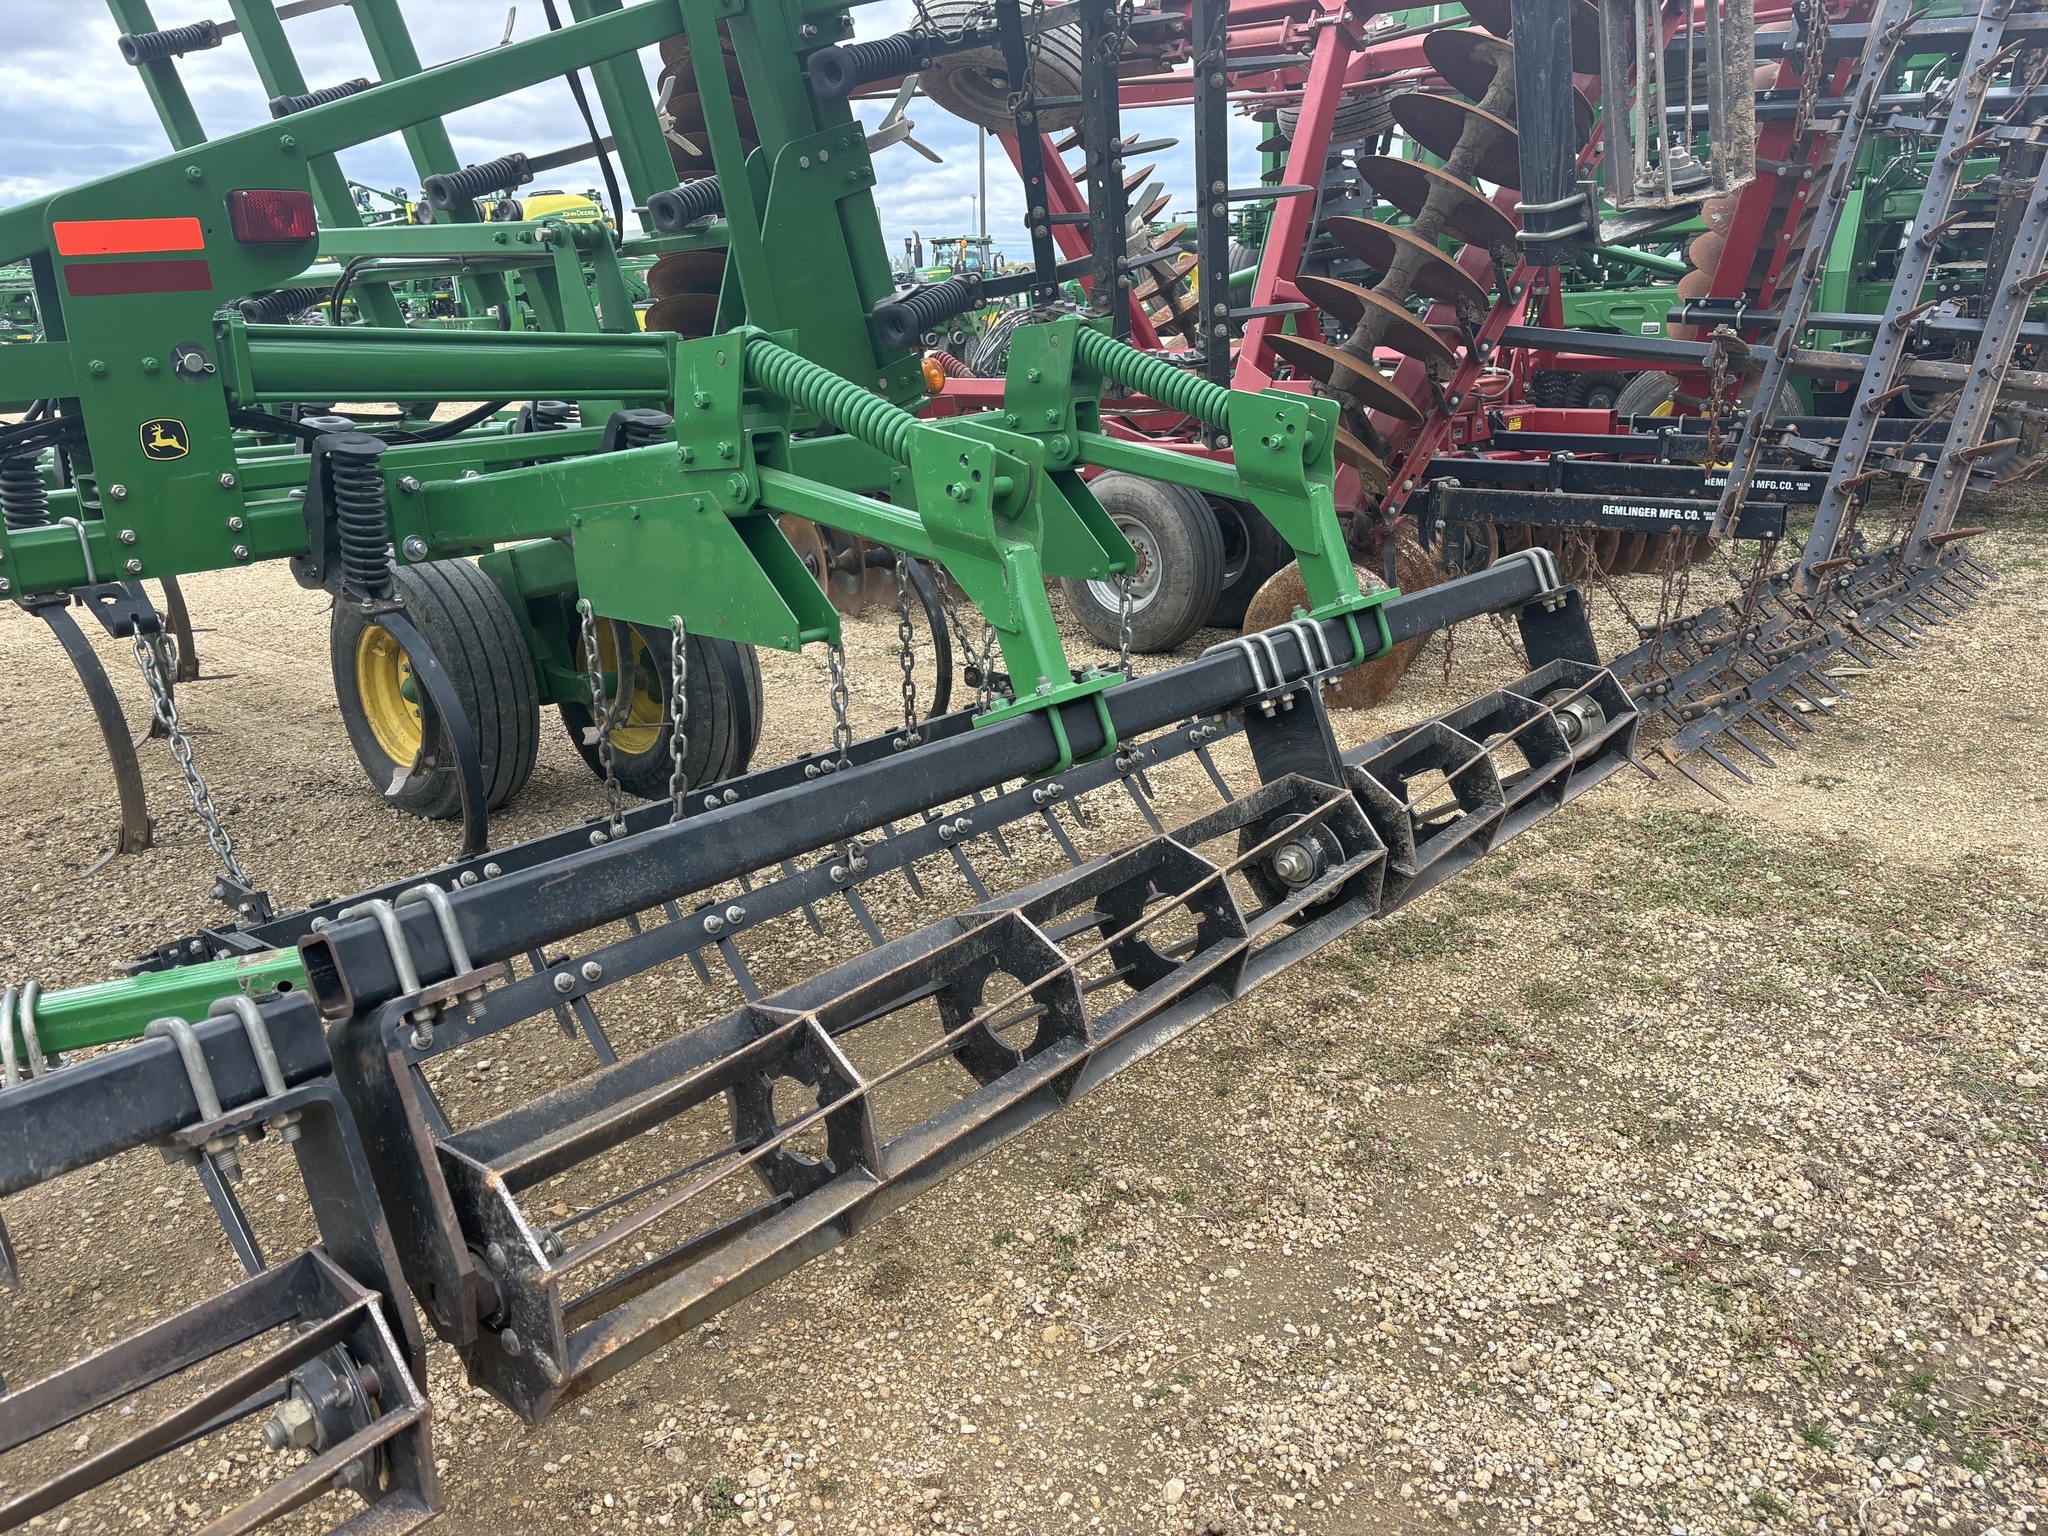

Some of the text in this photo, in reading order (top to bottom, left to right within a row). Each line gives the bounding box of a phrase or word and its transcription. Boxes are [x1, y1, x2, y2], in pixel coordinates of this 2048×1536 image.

[1756, 480, 1778, 490] MFG.
[1779, 480, 1794, 491] CO.
[1602, 504, 1700, 520] REMLINGER MFG. CO.
